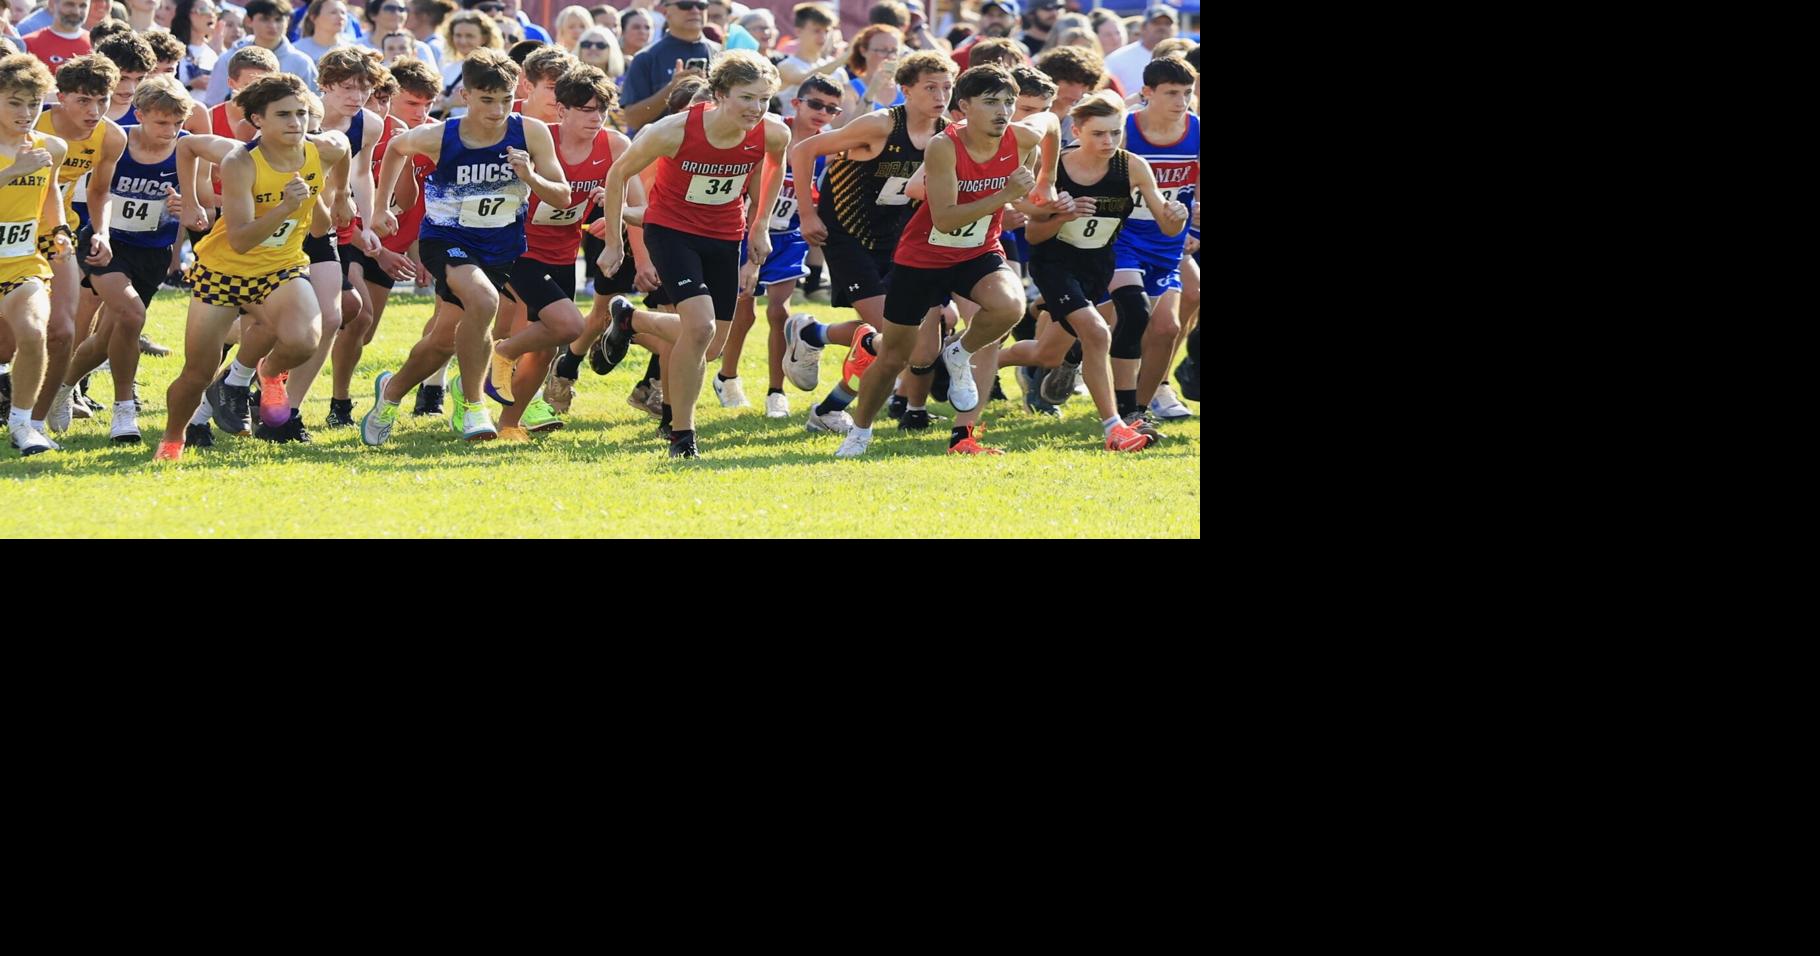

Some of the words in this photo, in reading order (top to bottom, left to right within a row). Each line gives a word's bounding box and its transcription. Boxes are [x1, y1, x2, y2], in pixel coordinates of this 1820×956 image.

[63, 158, 92, 168] ARYS
[681, 160, 754, 174] BRIDGEPORT
[457, 163, 512, 185] BUCS
[116, 176, 173, 196] BUCS
[705, 179, 733, 195] 34
[958, 176, 1010, 192] RIDGEPOR
[255, 193, 276, 203] ST.
[122, 201, 149, 220] 64
[478, 197, 506, 216] 67
[549, 207, 577, 220] 25
[1083, 219, 1098, 237] 8
